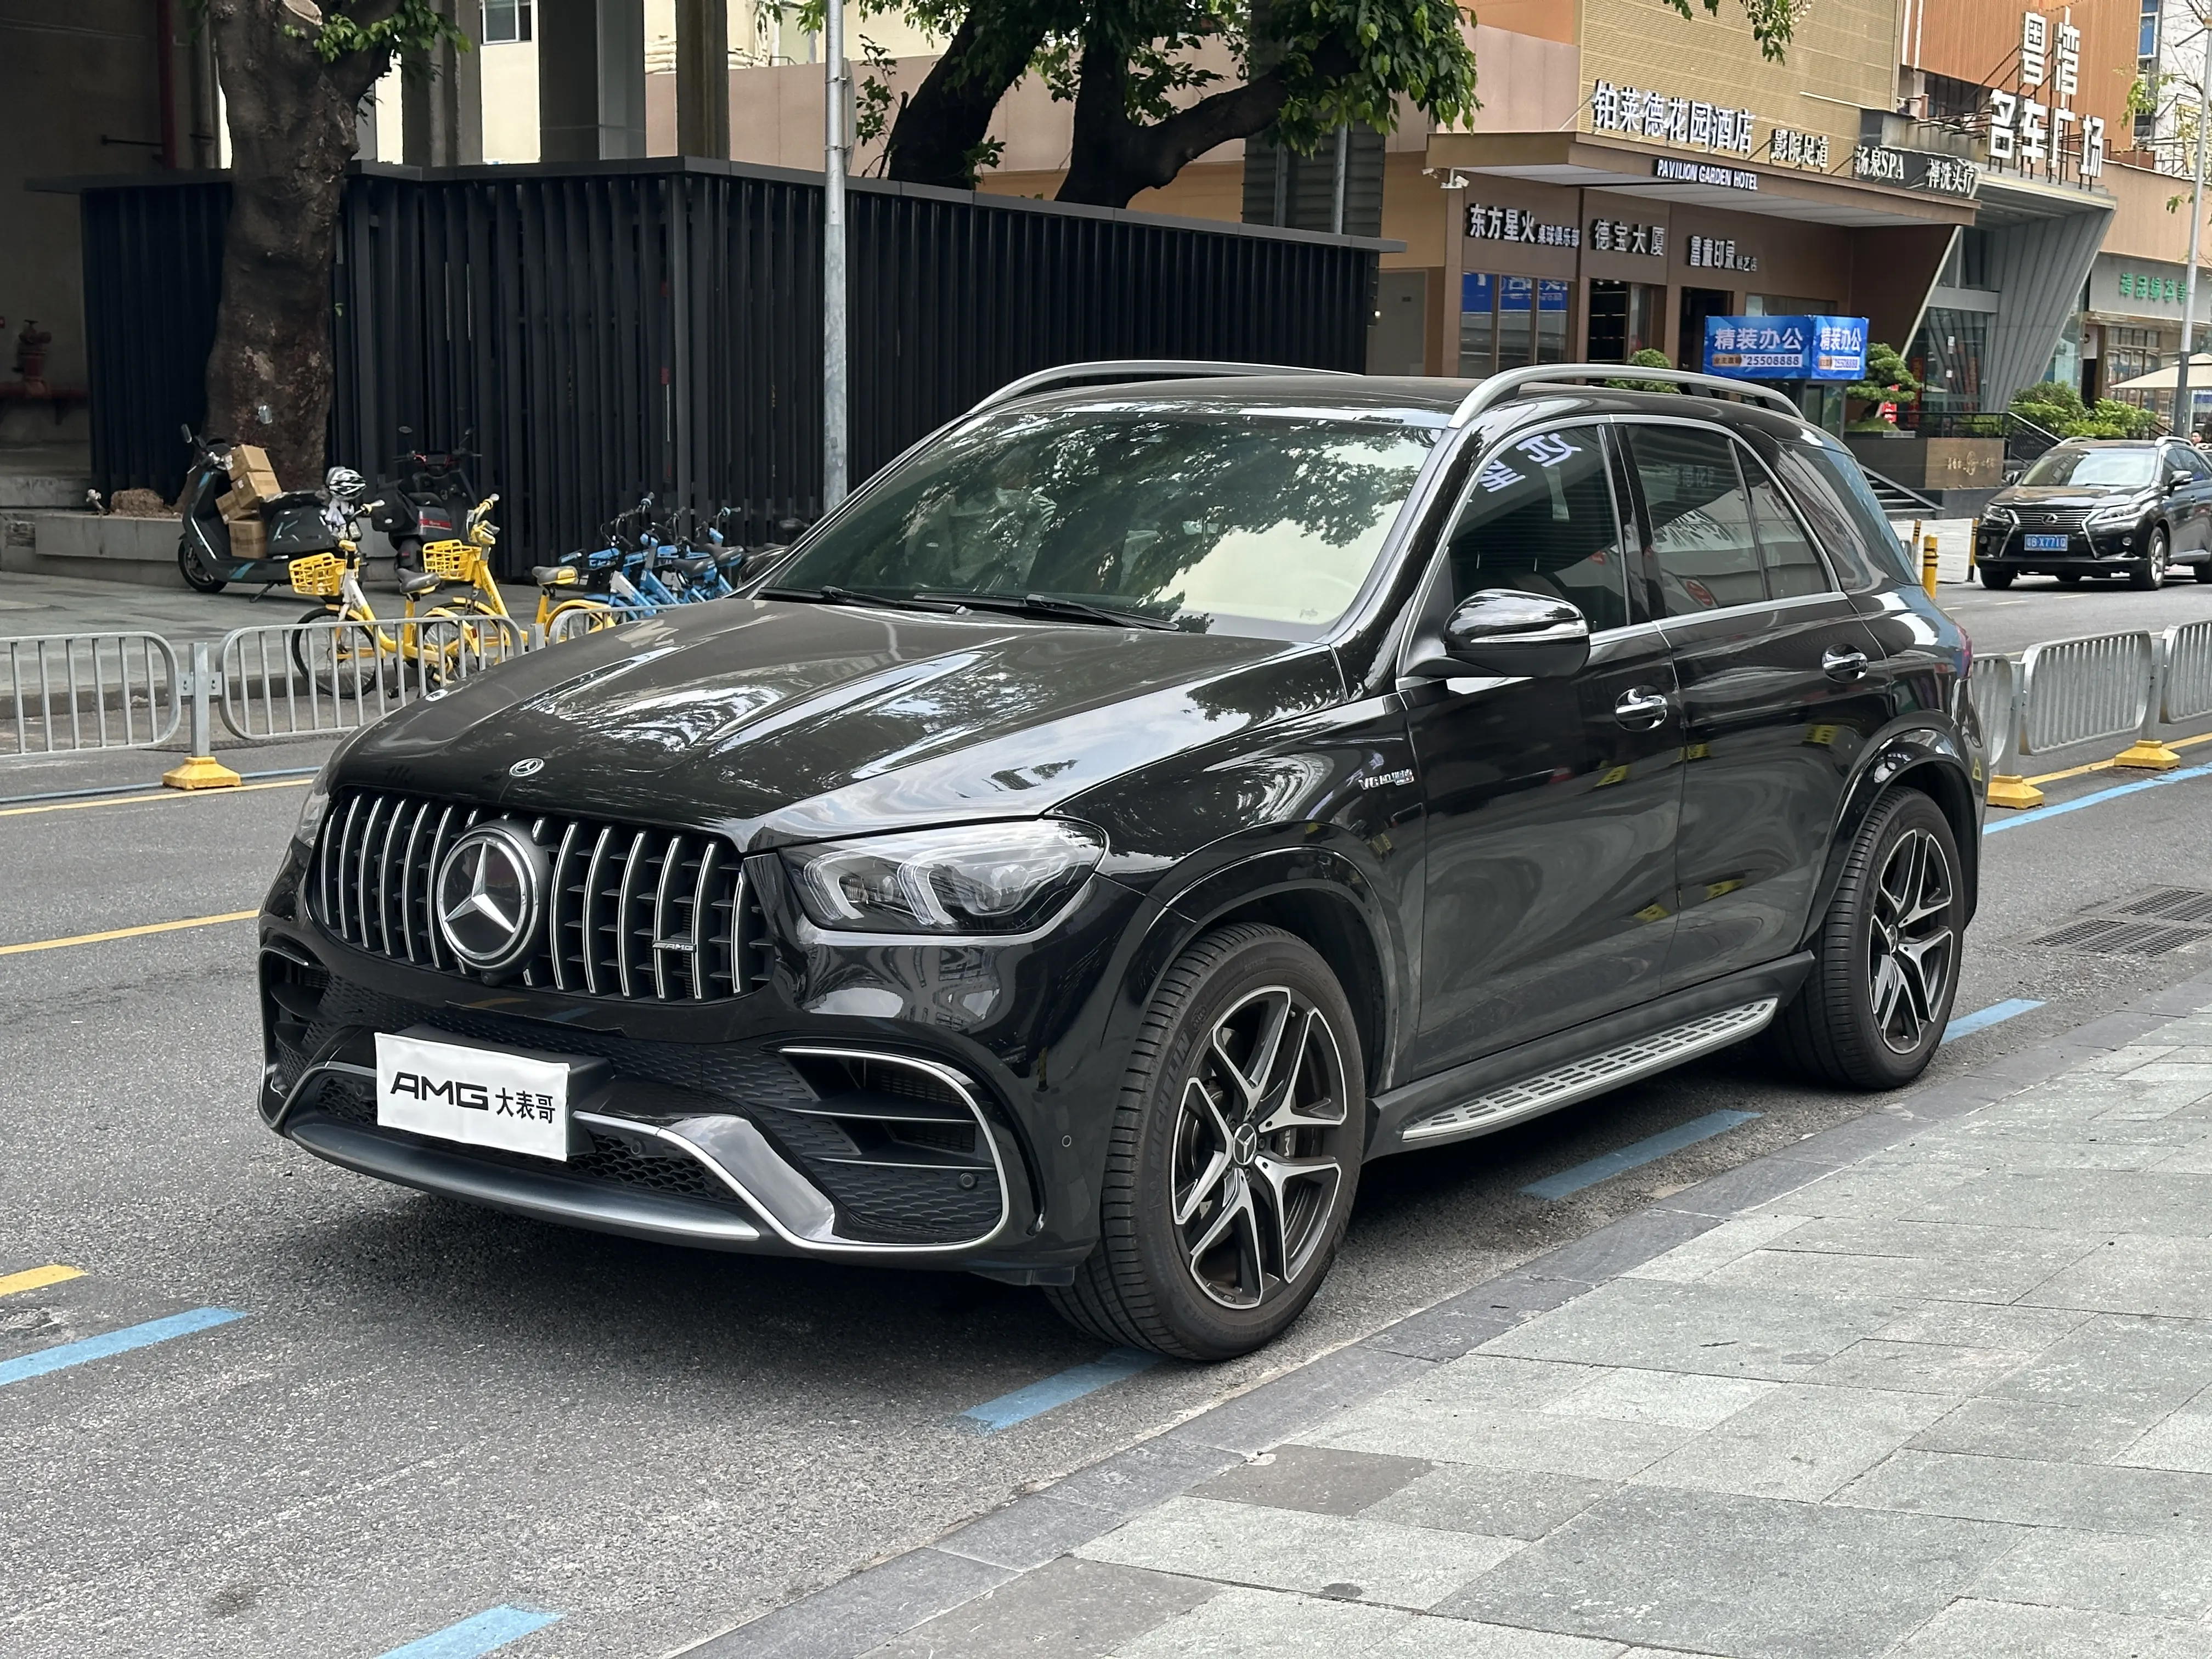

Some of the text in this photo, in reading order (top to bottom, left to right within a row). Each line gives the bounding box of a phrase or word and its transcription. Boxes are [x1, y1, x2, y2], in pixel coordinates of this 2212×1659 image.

[1593, 79, 1757, 153] 铂莱德花园酒店
[1990, 89, 2104, 178] 名车广场
[1657, 159, 1758, 190] PAVILION GARDEN HOTEL
[1470, 203, 1536, 243] 东方星火
[1595, 219, 1666, 256] 德宝大厦
[1714, 328, 1804, 351] 精装办公
[1820, 327, 1862, 352] 精装办公
[1747, 356, 1799, 365] 25508888
[390, 1071, 556, 1124] AMG 大表哥
